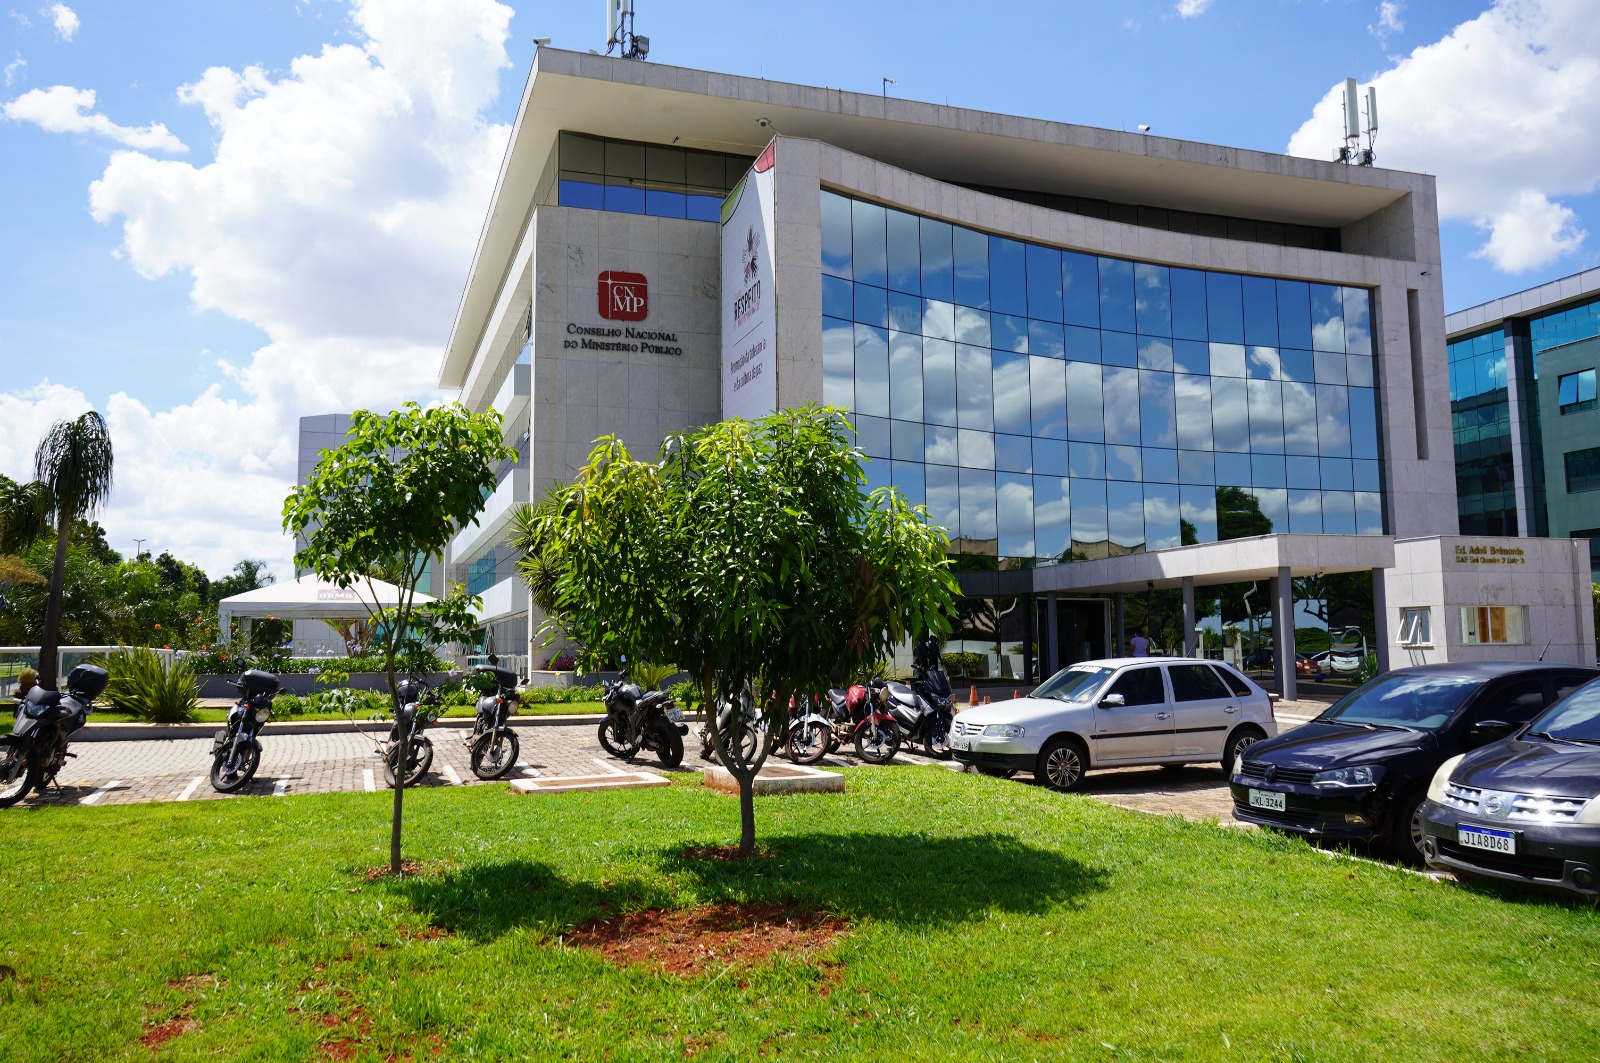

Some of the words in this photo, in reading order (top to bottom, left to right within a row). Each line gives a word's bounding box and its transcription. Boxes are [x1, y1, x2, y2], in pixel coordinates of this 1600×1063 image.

[613, 285, 635, 298] CN
[735, 280, 760, 320] RESPEITO
[613, 296, 645, 312] MP
[567, 323, 622, 337] CONSELHO
[625, 327, 678, 342] NACIONAL
[563, 340, 578, 349] DO
[580, 338, 638, 352] MINISTÉRIO
[641, 342, 682, 355] PÚBLICO
[1464, 833, 1509, 851] JIA8D68
